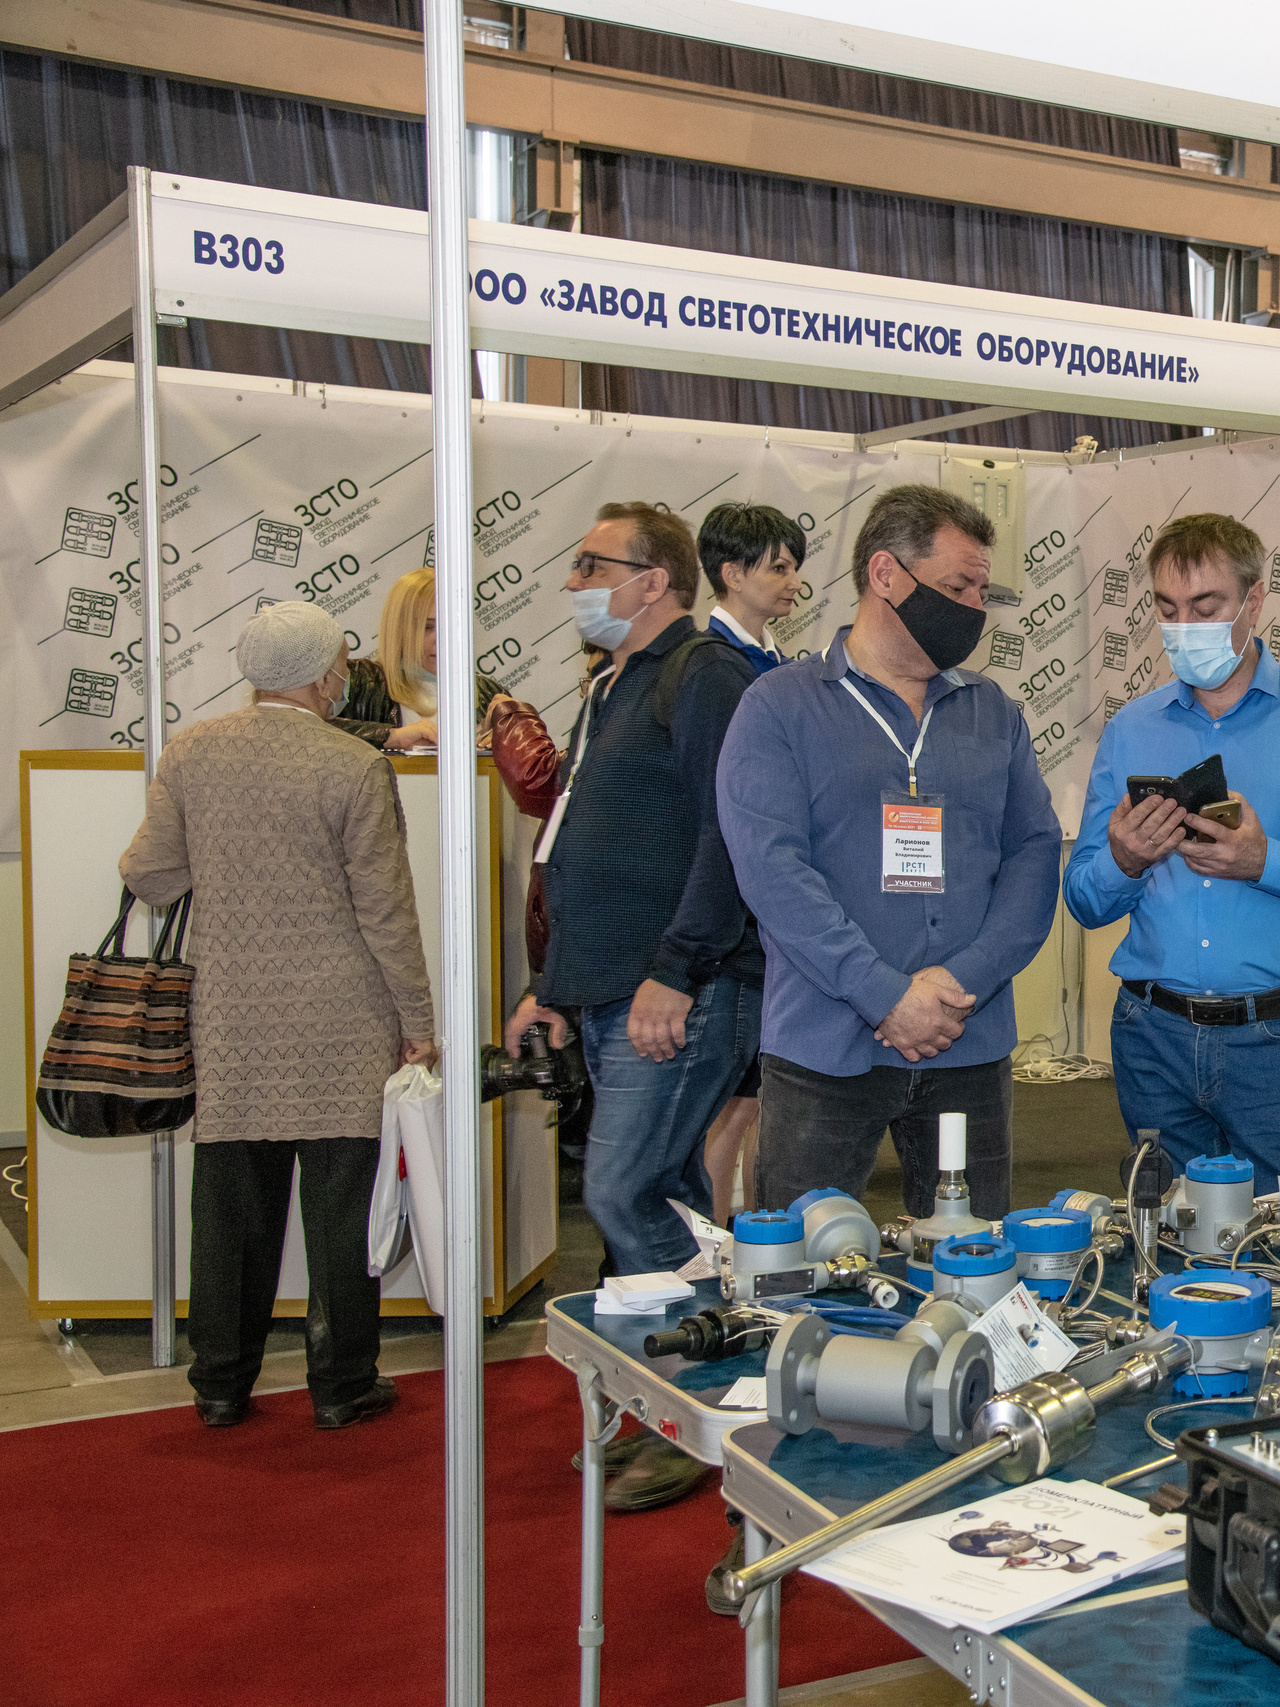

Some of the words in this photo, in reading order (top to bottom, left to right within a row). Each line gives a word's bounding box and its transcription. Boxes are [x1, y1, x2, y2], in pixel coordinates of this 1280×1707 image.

[193, 230, 285, 275] В303
[469, 268, 527, 304] ОО
[539, 279, 668, 329] «ЗАВОД
[678, 294, 962, 357] СВЕТОТЕХНИЧЕСКОЕ
[976, 331, 1200, 384] ОБОРУДОВАНИЕ»
[107, 464, 178, 515] ЗСО
[293, 478, 359, 526] ЗСТО
[308, 517, 332, 534] ЗАВОД
[313, 497, 381, 541] СВЕТОТЕХНИЧЕСКОЕ
[318, 512, 372, 548] ОБОРУДОВАНИЕ
[475, 528, 497, 545] ЗАВОД
[479, 508, 541, 551] СВЕТОТЕХНИЧЕСКОЕ
[483, 524, 533, 558] ОБОРУДОВАНИЕ
[1024, 530, 1066, 572] ЗСТО
[1125, 525, 1153, 571] ЗСТО
[109, 543, 180, 594] ЗСО
[295, 554, 360, 602] ЗСТО
[315, 593, 333, 607] АВОД
[475, 602, 497, 619] ЗАВОД
[479, 582, 542, 625] СВЕТОТЕХНИЧЕСКОЕ
[484, 597, 533, 632] ОБОРУДОВАНИЕ
[1019, 593, 1066, 635] ЗСТО
[1125, 590, 1153, 636] ЗСТО
[772, 616, 792, 633] ЗАВОД
[780, 611, 823, 644] ОБОРУДОВАНИЕ
[1028, 627, 1046, 642] ЗАВОД
[110, 622, 181, 674] ЗСО
[475, 637, 522, 676] СТО
[1018, 658, 1066, 700] ЗСТО
[1124, 656, 1152, 700] ЗСТО
[1028, 692, 1046, 707] ЗАВОД
[1031, 721, 1065, 755] СТО
[895, 838, 930, 846] Ларионов
[894, 879, 932, 887] УЧАСТНИК
[1031, 1486, 1144, 1519] НОМЕНКЛАТУРНЫЙ
